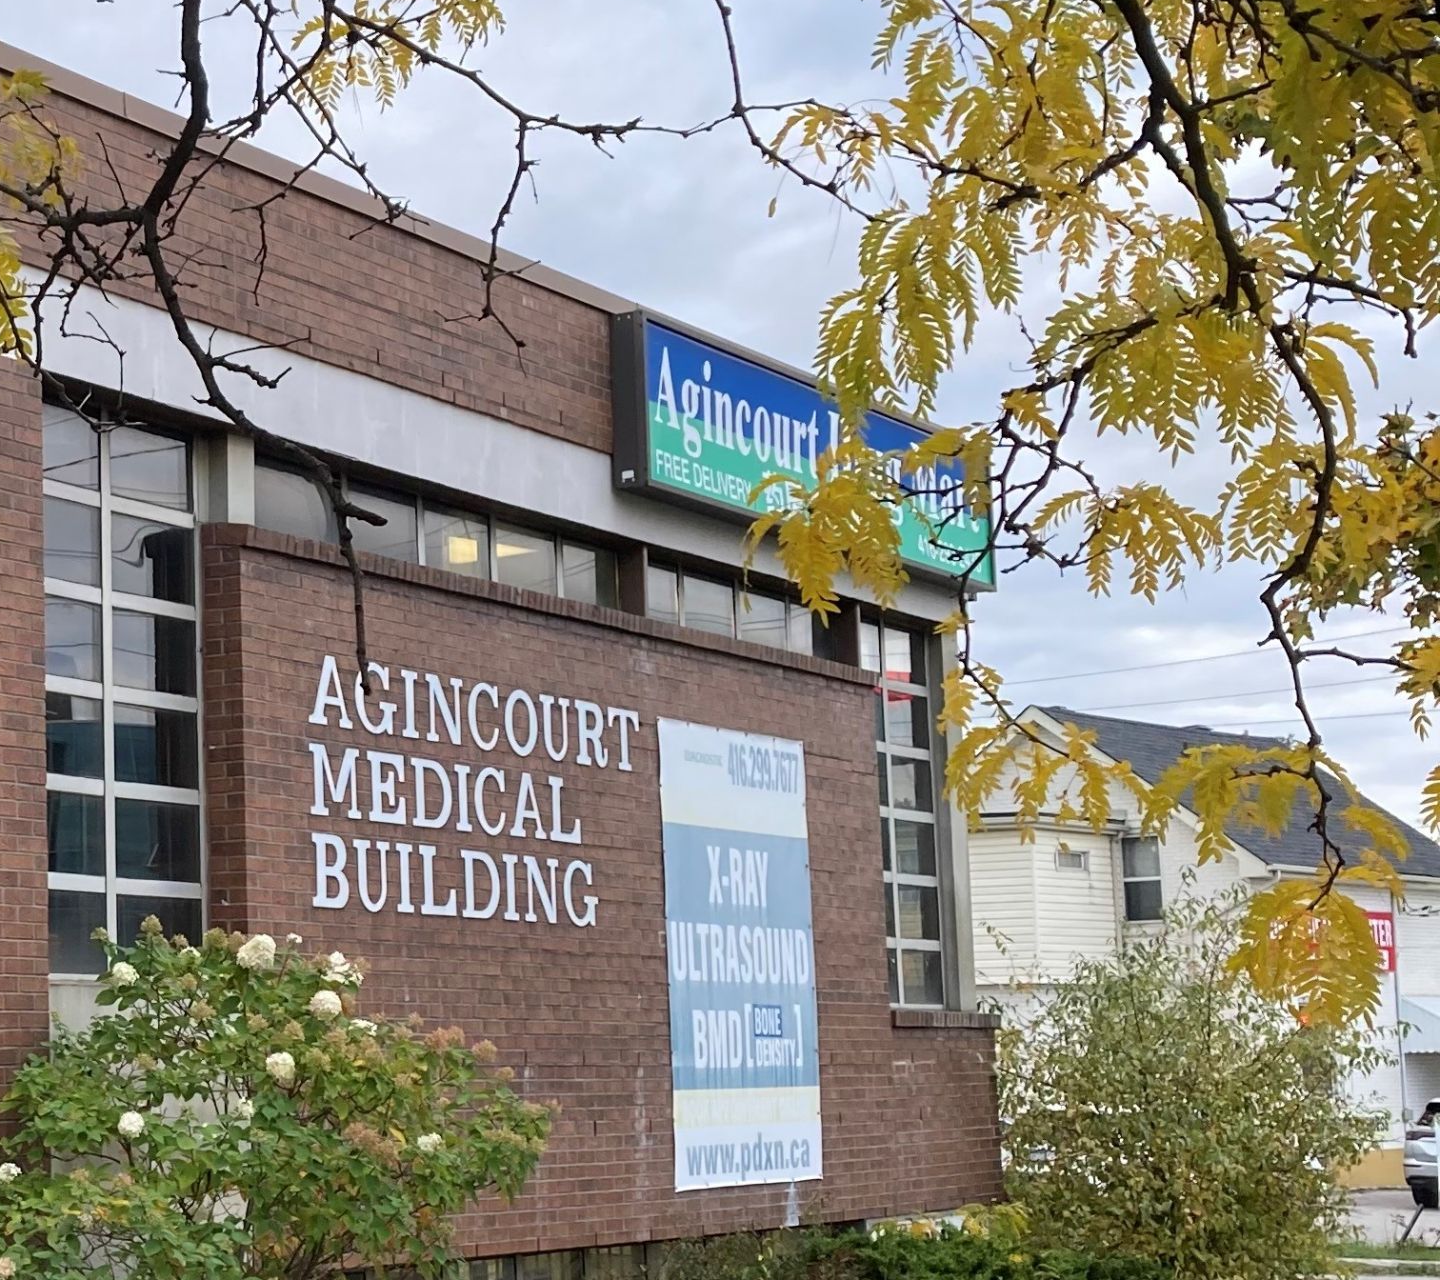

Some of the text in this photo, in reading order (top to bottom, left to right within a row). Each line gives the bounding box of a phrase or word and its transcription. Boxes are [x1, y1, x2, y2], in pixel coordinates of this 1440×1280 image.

[655, 346, 819, 480] Agincourt
[655, 448, 690, 485] FREE
[693, 462, 752, 504] DELIVERY
[308, 655, 640, 772] AGINCOURT
[308, 742, 582, 845] MEDICAL
[727, 742, 799, 795] 416.299.7677
[311, 832, 599, 927] BUILDING
[706, 845, 769, 908] X-RAY
[670, 920, 810, 985] ULTRASOUND
[686, 1131, 811, 1181] www.pdxn.ca
